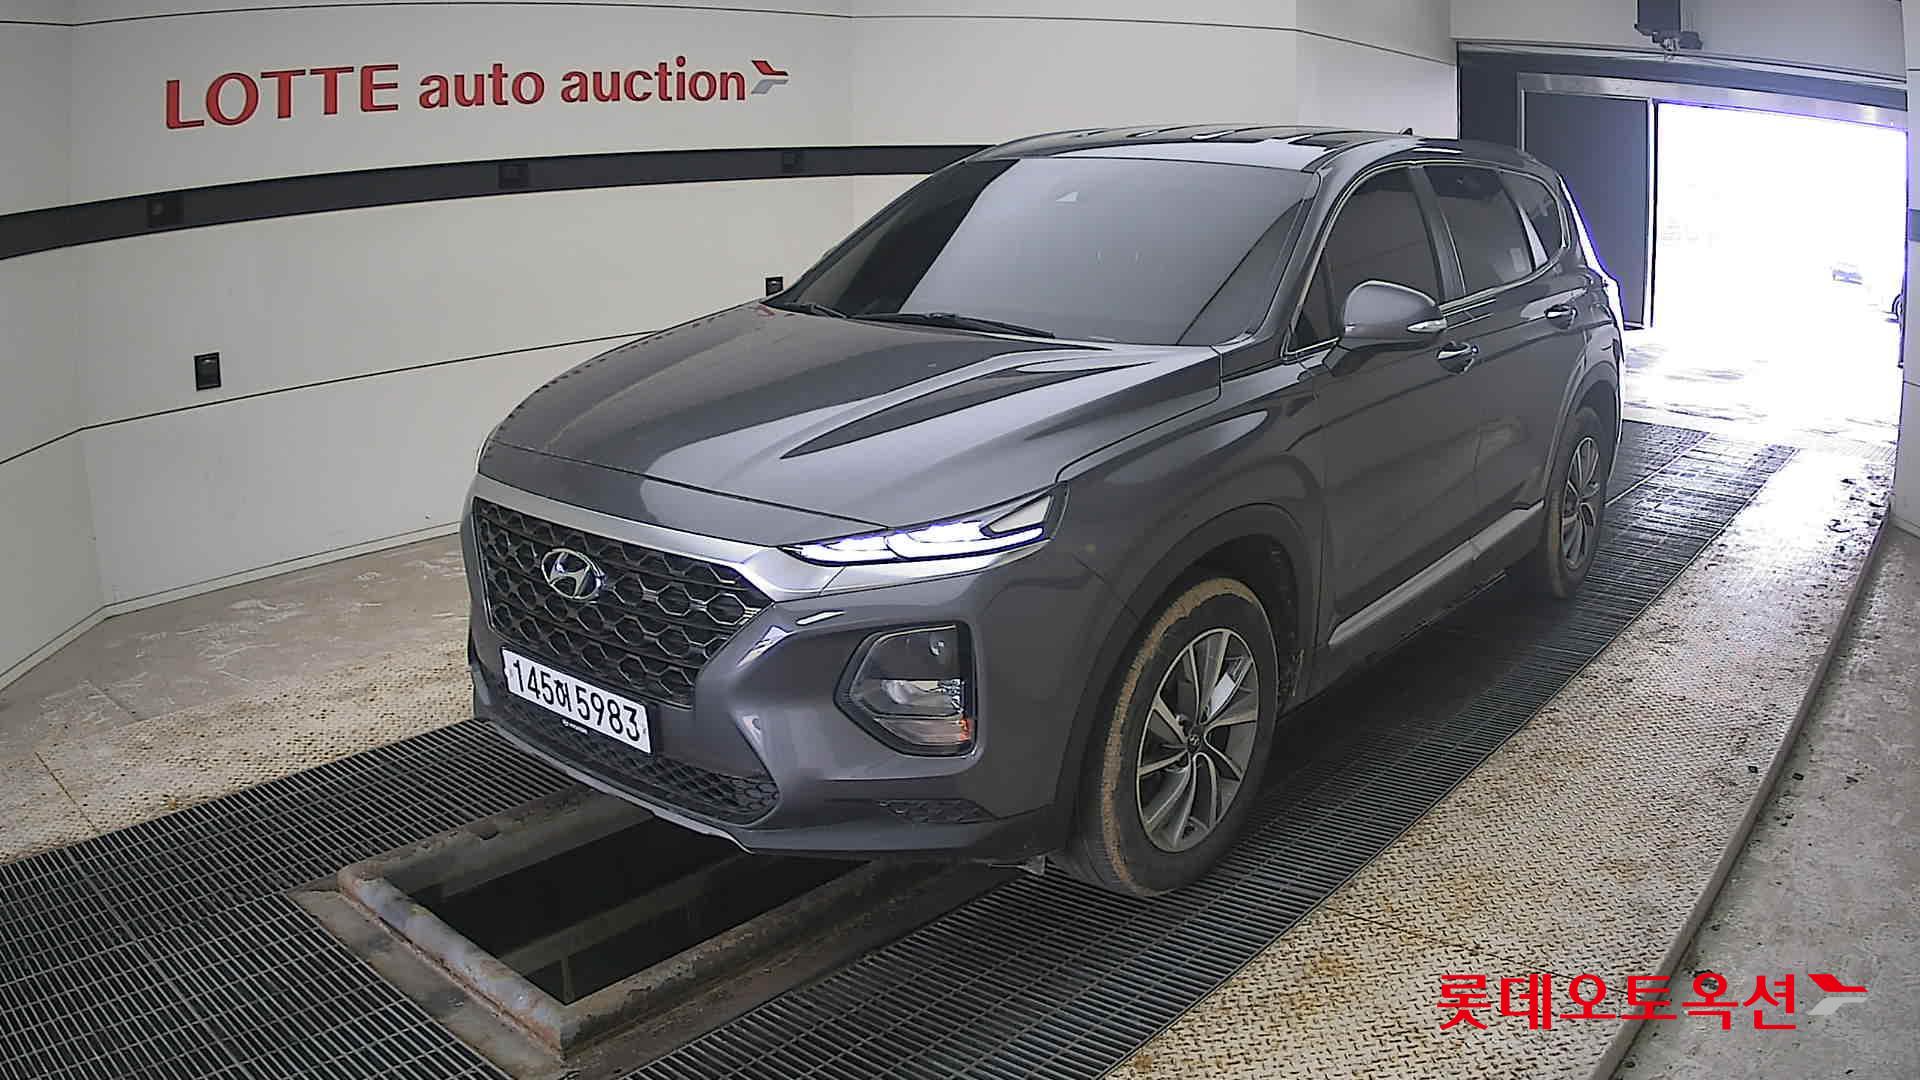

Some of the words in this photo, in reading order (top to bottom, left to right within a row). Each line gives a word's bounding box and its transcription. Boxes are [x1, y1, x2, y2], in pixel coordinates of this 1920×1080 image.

[165, 63, 399, 130] LOTTE
[418, 62, 546, 109] auto
[560, 55, 746, 103] auction
